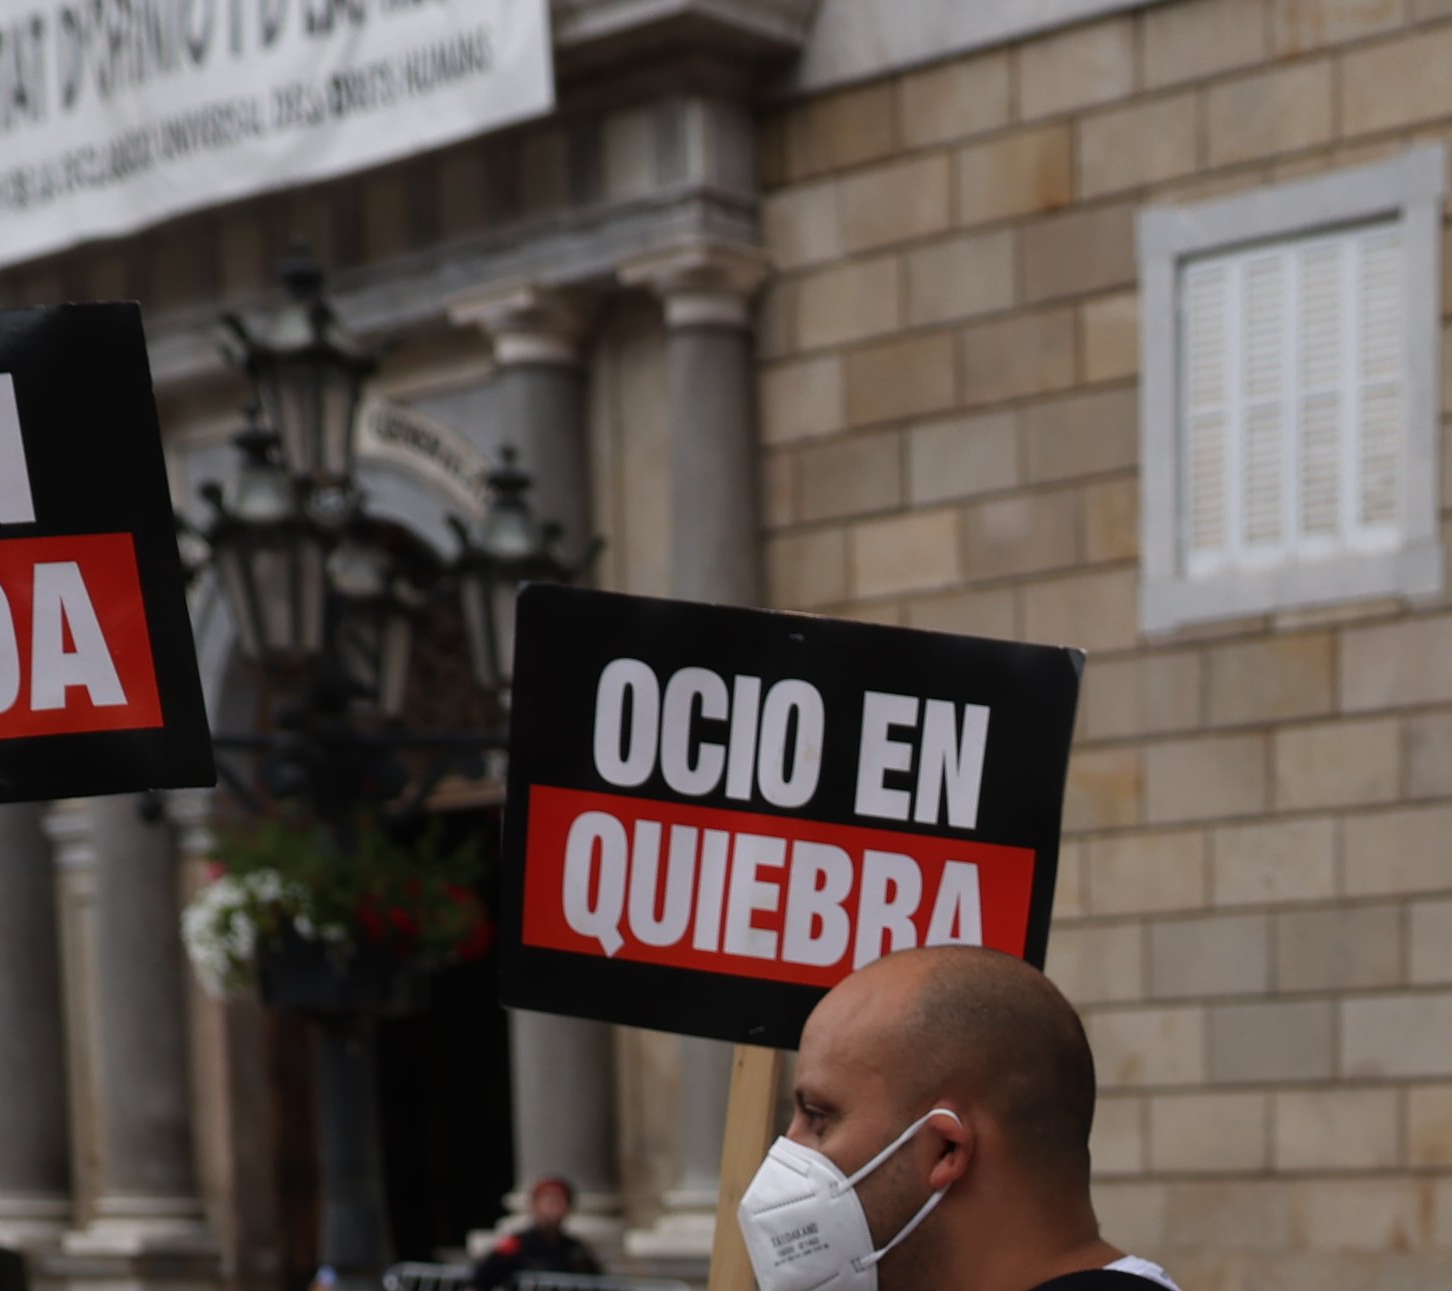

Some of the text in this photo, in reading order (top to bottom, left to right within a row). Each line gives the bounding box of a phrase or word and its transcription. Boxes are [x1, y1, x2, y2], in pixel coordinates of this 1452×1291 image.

[593, 658, 991, 830] OCIO EN
[562, 810, 983, 970] QUIEBRA
